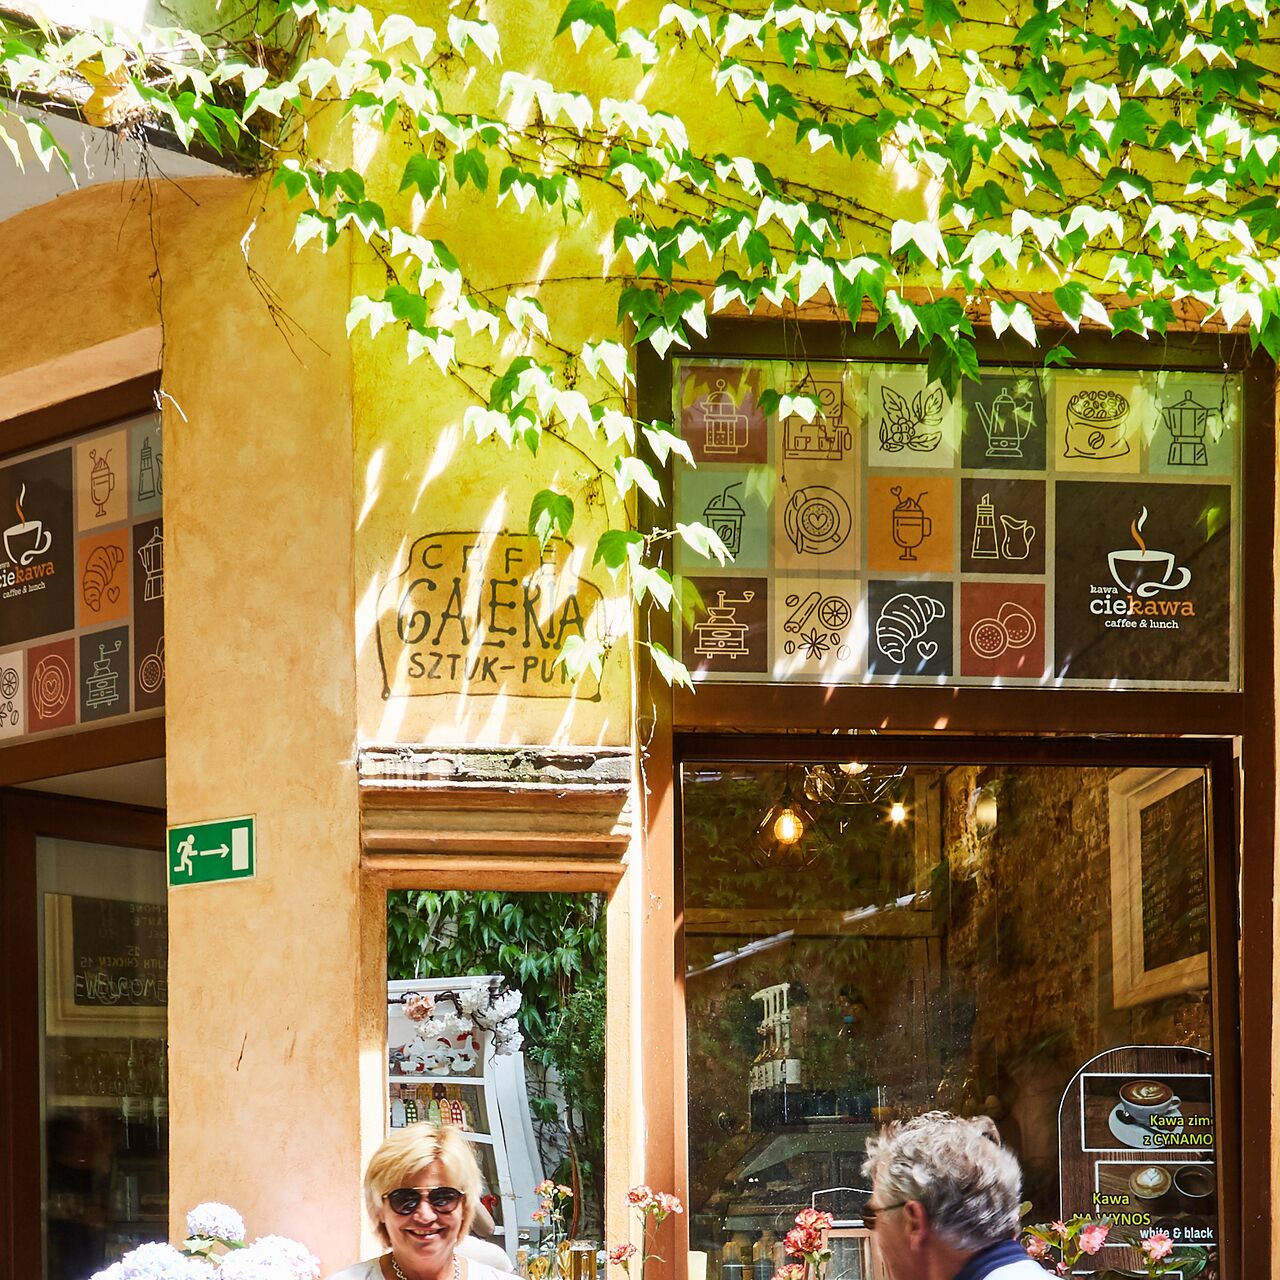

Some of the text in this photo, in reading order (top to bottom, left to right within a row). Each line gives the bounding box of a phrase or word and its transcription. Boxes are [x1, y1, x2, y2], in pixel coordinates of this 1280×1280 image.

[22, 585, 27, 594] &
[28, 581, 46, 592] lunch
[1089, 585, 1118, 594] kawa
[1089, 594, 1195, 616] ciekawa
[397, 577, 585, 650] GALERIA
[1104, 619, 1179, 629] caffee & lunch
[1150, 1114, 1213, 1126] Kawa zim
[1144, 1133, 1213, 1145] z CYNAMO
[1092, 1193, 1130, 1205] Kawa
[1173, 1227, 1182, 1239] &
[1184, 1227, 1213, 1239] black
